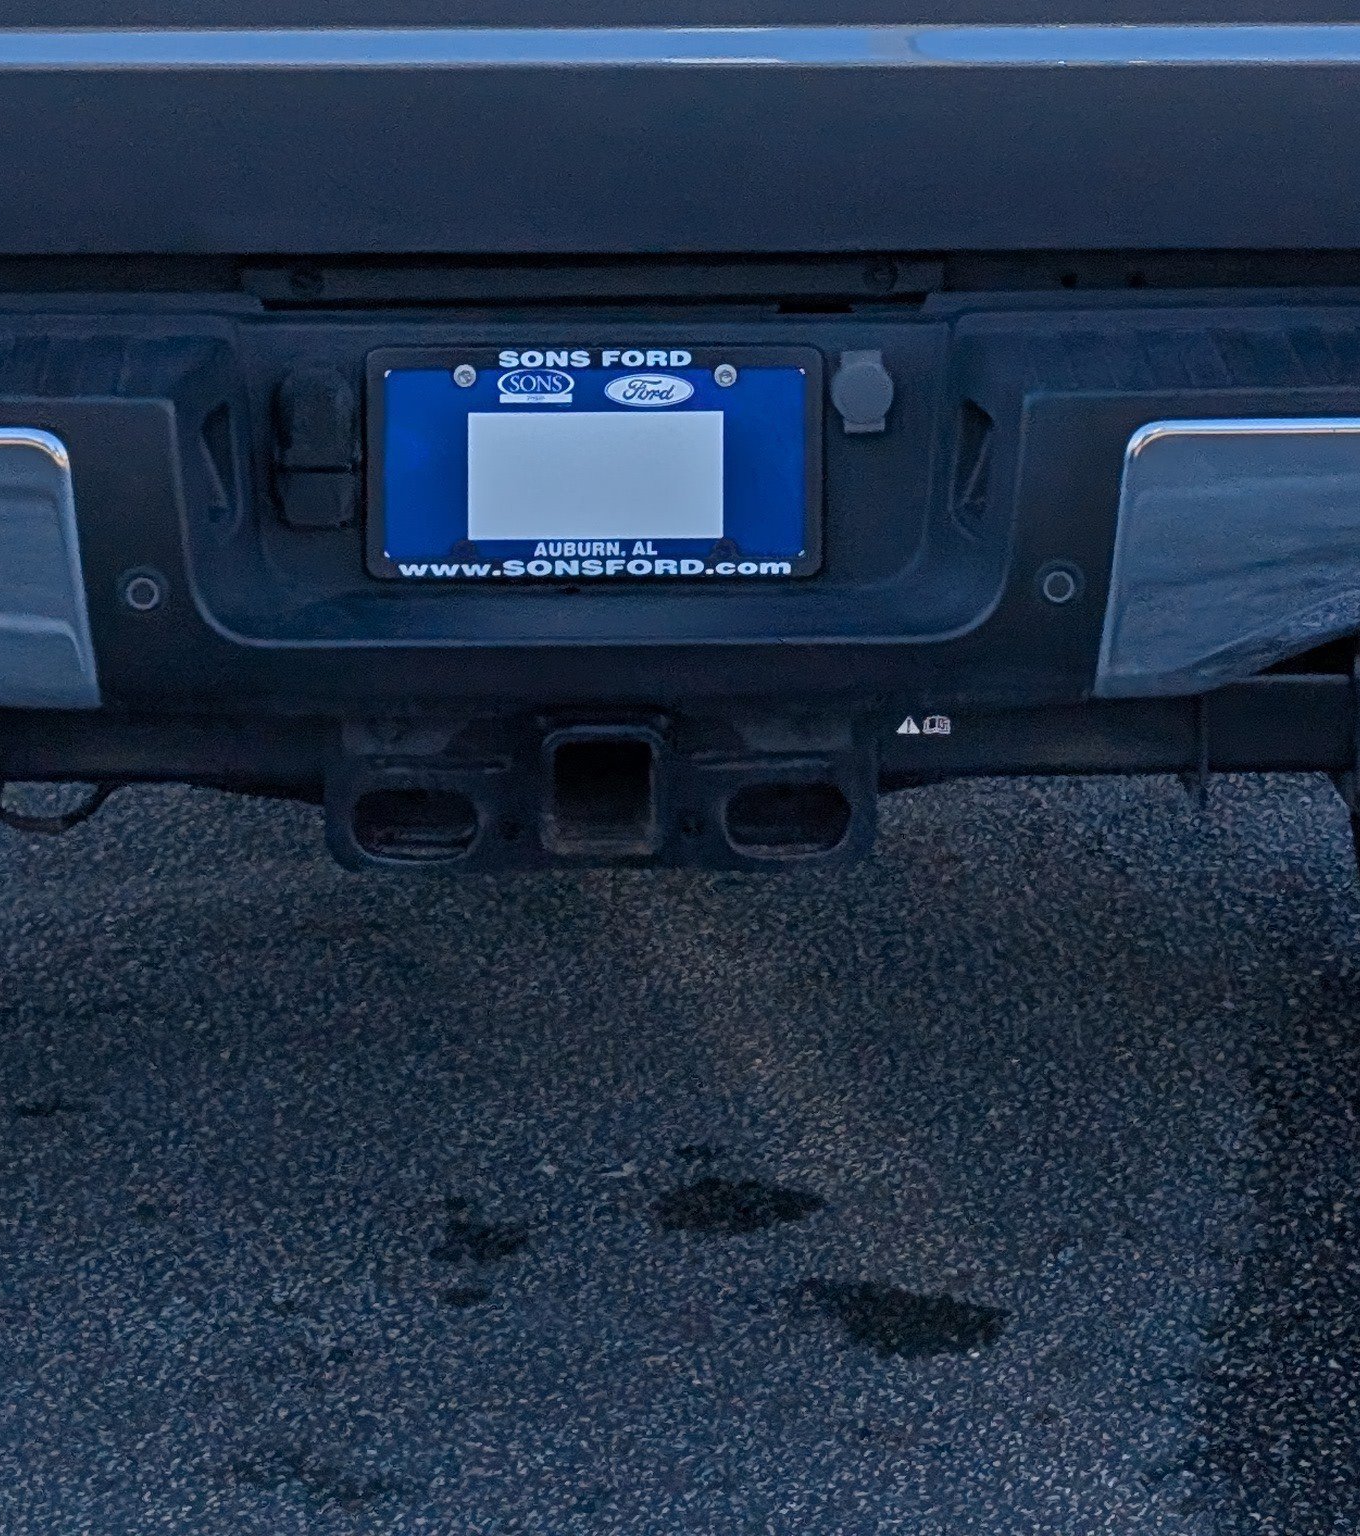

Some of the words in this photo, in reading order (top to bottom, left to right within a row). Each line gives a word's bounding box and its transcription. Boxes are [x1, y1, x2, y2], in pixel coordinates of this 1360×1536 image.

[498, 350, 591, 368] SONS
[602, 350, 692, 368] FORD
[509, 374, 563, 393] SONS
[622, 378, 675, 402] Ford
[632, 541, 659, 557] AL
[398, 559, 792, 577] www.SONSFORD.com
